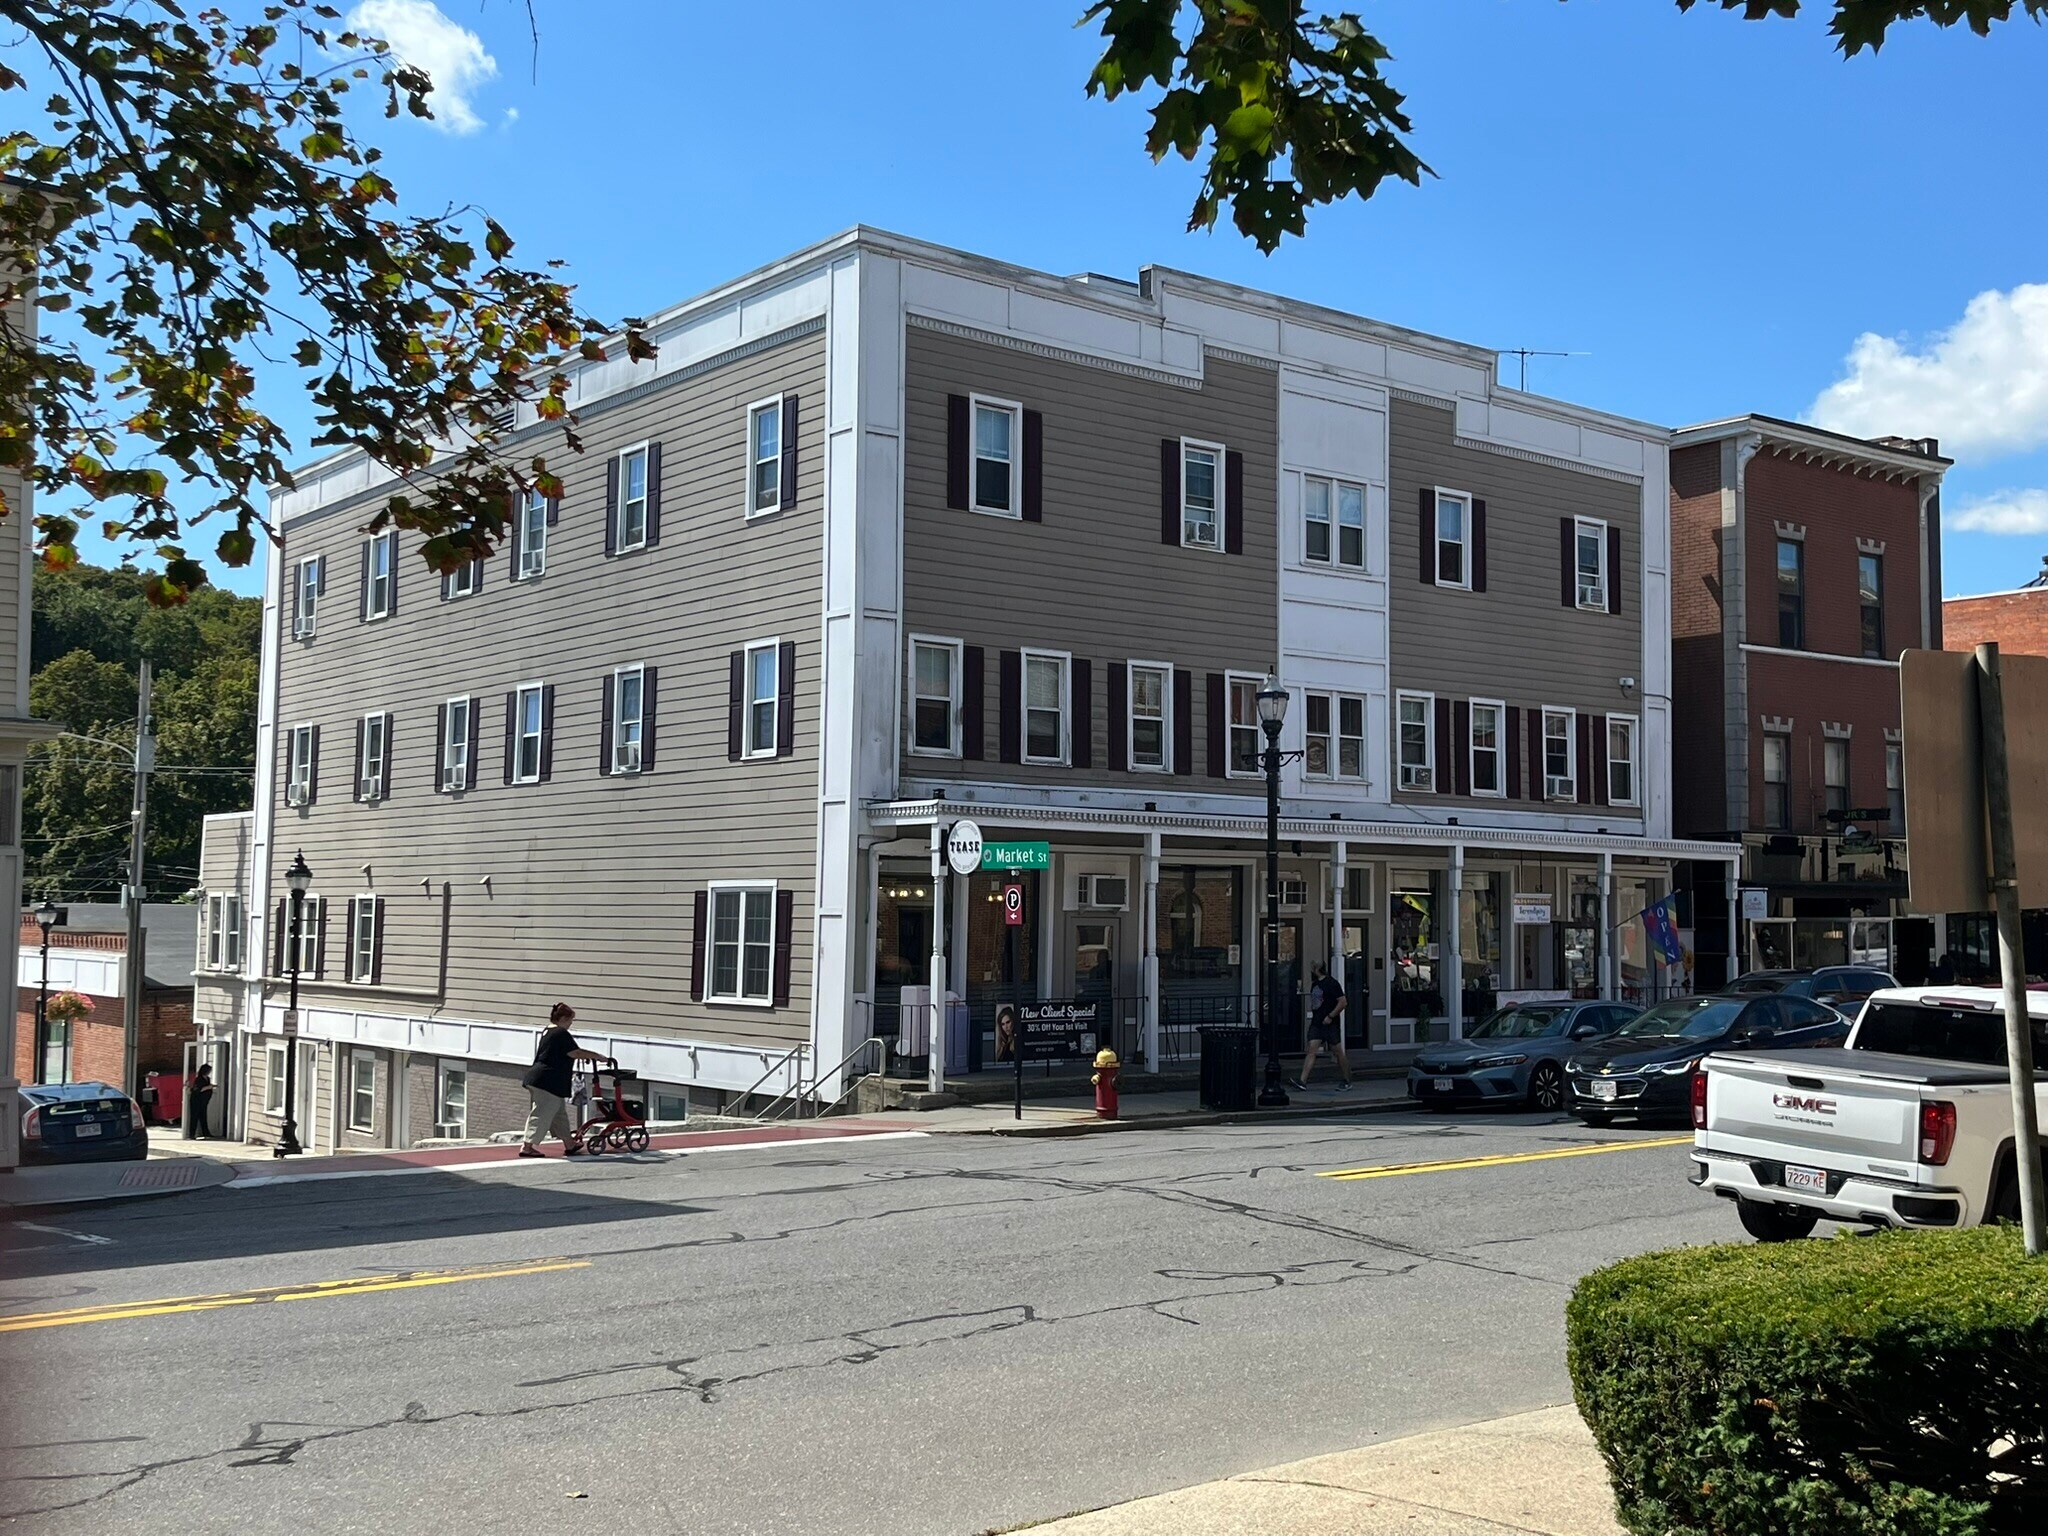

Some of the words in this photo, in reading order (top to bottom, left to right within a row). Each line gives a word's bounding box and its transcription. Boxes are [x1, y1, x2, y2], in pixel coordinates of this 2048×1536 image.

[950, 841, 980, 853] TEASE
[996, 848, 1034, 863] Market
[1037, 852, 1047, 862] St
[1010, 893, 1017, 907] P
[1020, 1006, 1039, 1019] New
[1040, 1004, 1066, 1018] Client
[1066, 1003, 1096, 1022] Special
[1027, 1023, 1041, 1032] 30%
[1041, 1023, 1051, 1031] Off
[1052, 1022, 1065, 1031] Your
[1074, 1021, 1088, 1030] Visit
[1773, 1094, 1837, 1115] GMC
[1787, 1171, 1811, 1186] 7229
[1813, 1175, 1825, 1189] KE
